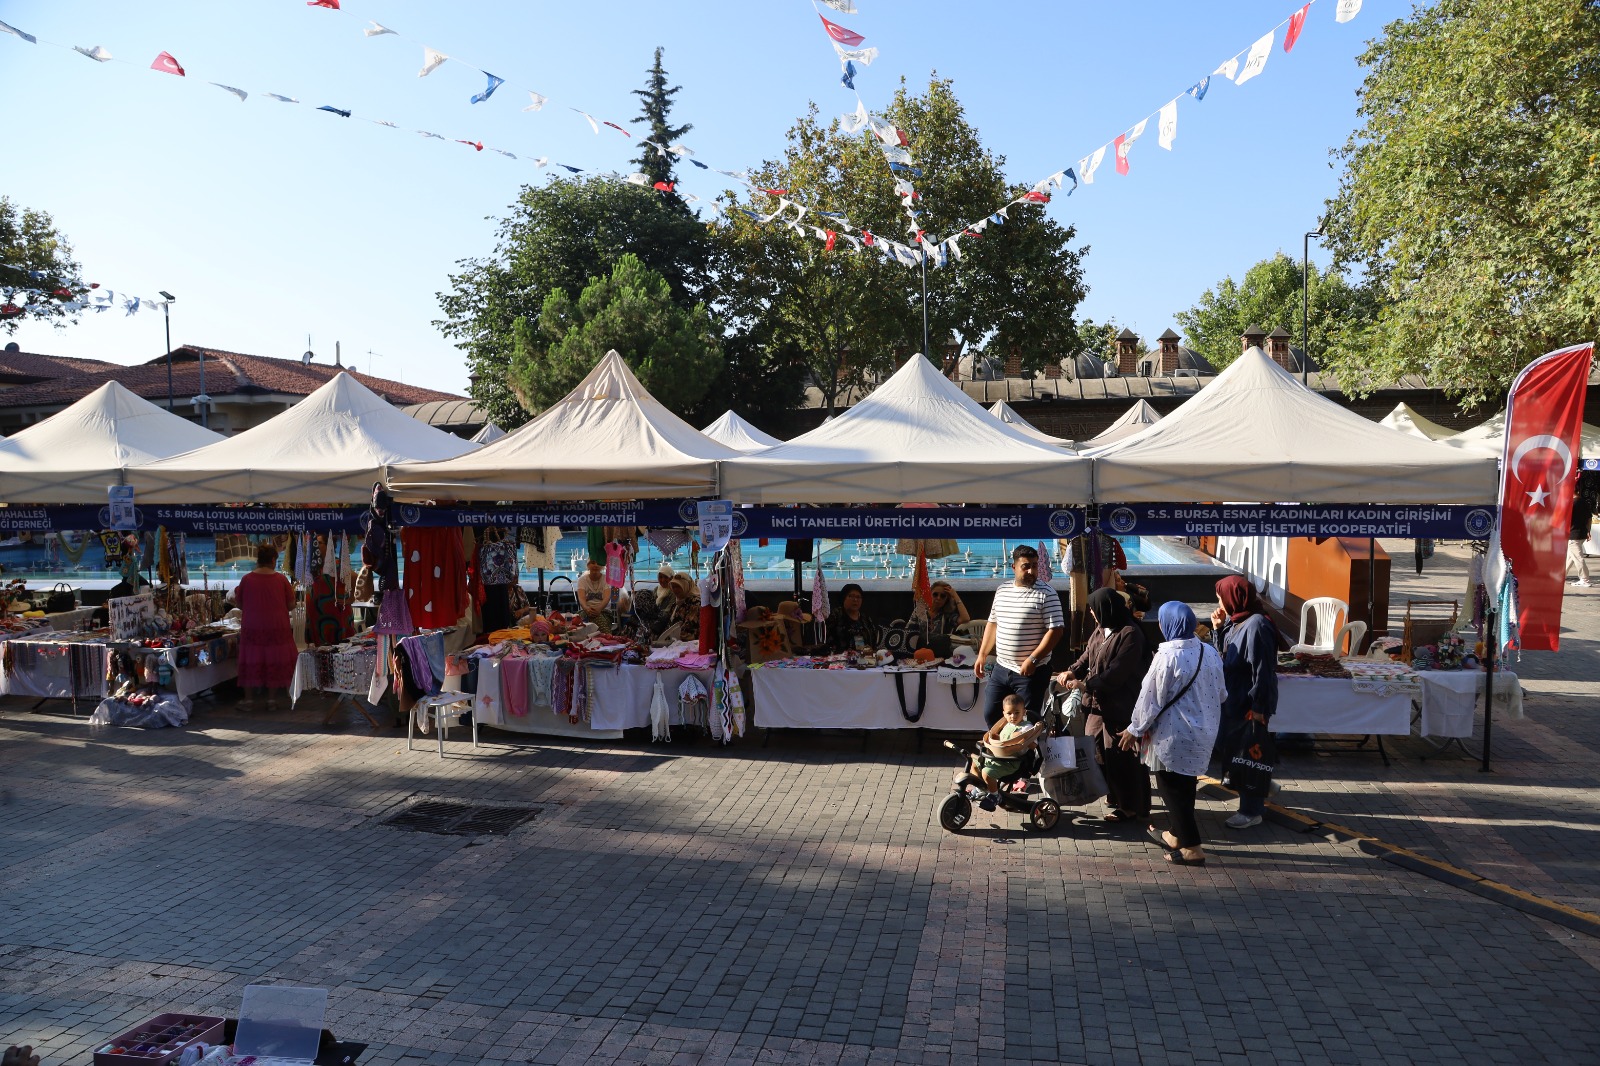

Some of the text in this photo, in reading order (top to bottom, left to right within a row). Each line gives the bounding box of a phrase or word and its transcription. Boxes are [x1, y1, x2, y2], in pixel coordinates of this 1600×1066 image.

[157, 510, 344, 523] S.S. BURSA LOTUS KADIN GİRİŞİMİ ÜRETİM
[458, 511, 636, 526] ÜRETİM VE İŞLETME KOOPERATİFİ
[771, 515, 1022, 528] İNCİ TANELERİ ÜRETİCİ KADIN DERNEĞİ
[1147, 508, 1452, 523] S.S. BURSA ESNAF KADINLARI KADIN GİRİŞİMİ
[11, 518, 52, 529] DERNEĞİ
[192, 522, 204, 530] VE
[206, 520, 243, 532] İŞLETME
[1185, 521, 1411, 535] ÜRETİM VE İŞLETME KOOPERATİFİ
